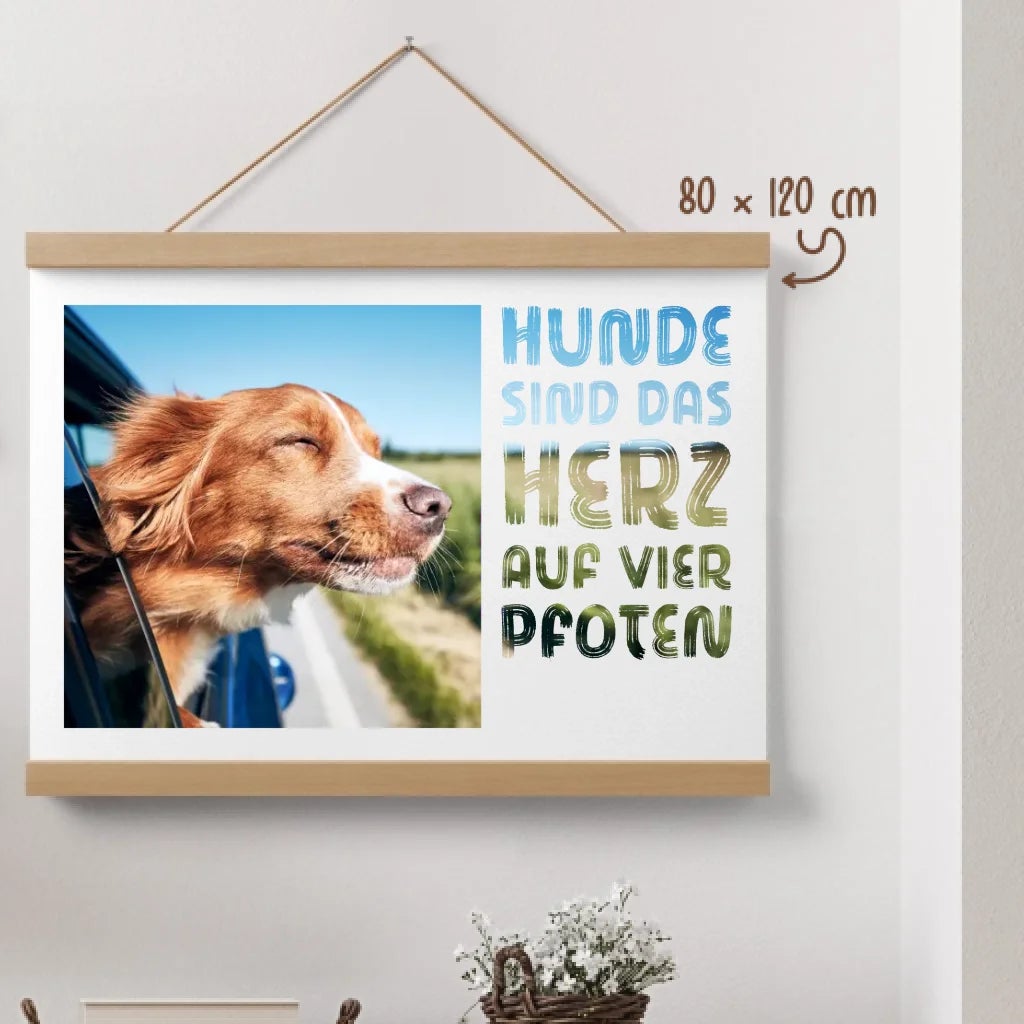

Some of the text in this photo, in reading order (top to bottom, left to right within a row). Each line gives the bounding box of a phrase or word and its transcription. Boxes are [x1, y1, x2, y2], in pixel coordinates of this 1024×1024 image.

[501, 305, 732, 367] HUNDE
[501, 380, 732, 426] SIND DAS
[502, 440, 732, 530] HERZ
[501, 542, 732, 591] AUF VIER
[501, 603, 733, 661] PFOTEN
